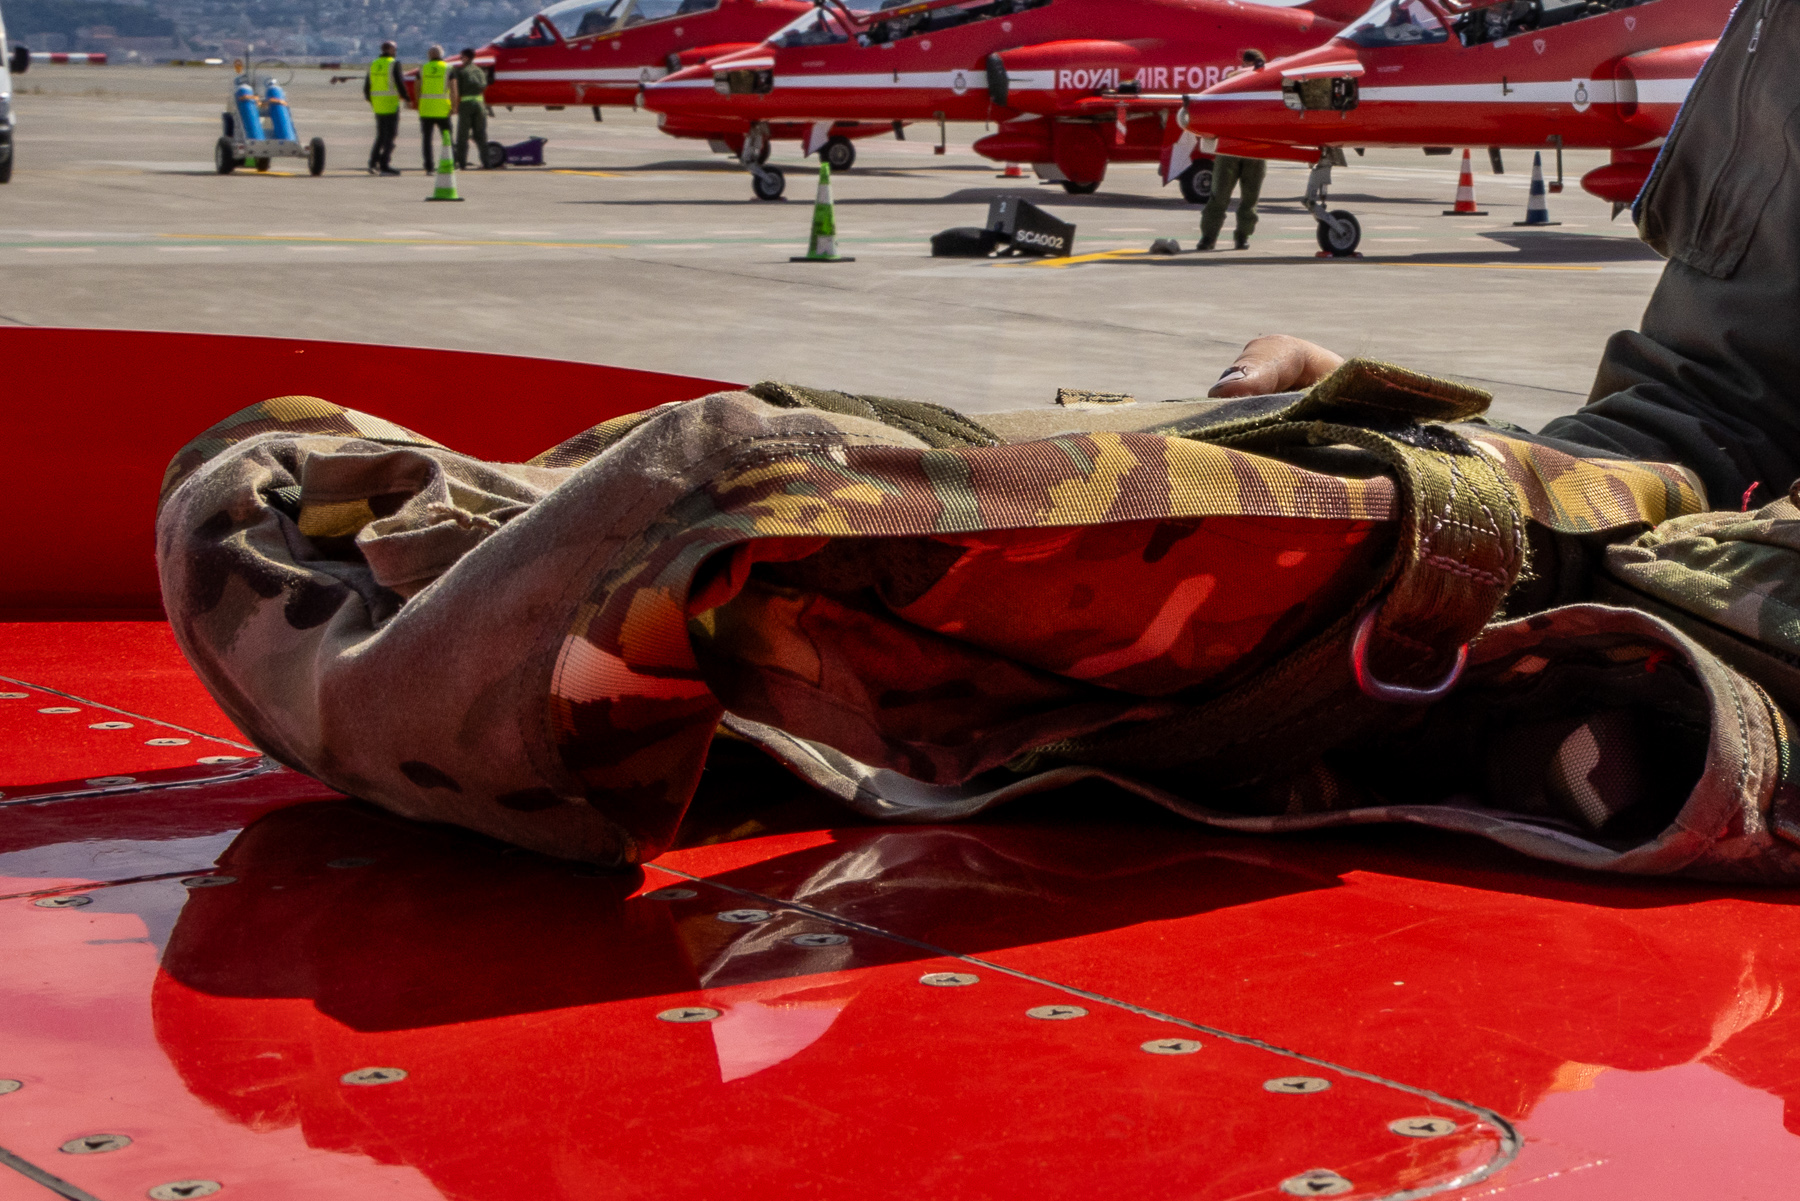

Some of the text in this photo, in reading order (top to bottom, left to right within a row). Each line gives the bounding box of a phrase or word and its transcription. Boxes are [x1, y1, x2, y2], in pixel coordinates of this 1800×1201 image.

[1059, 67, 1120, 90] ROYAL
[1133, 66, 1170, 89] AIR
[1016, 229, 1065, 249] SCA002
